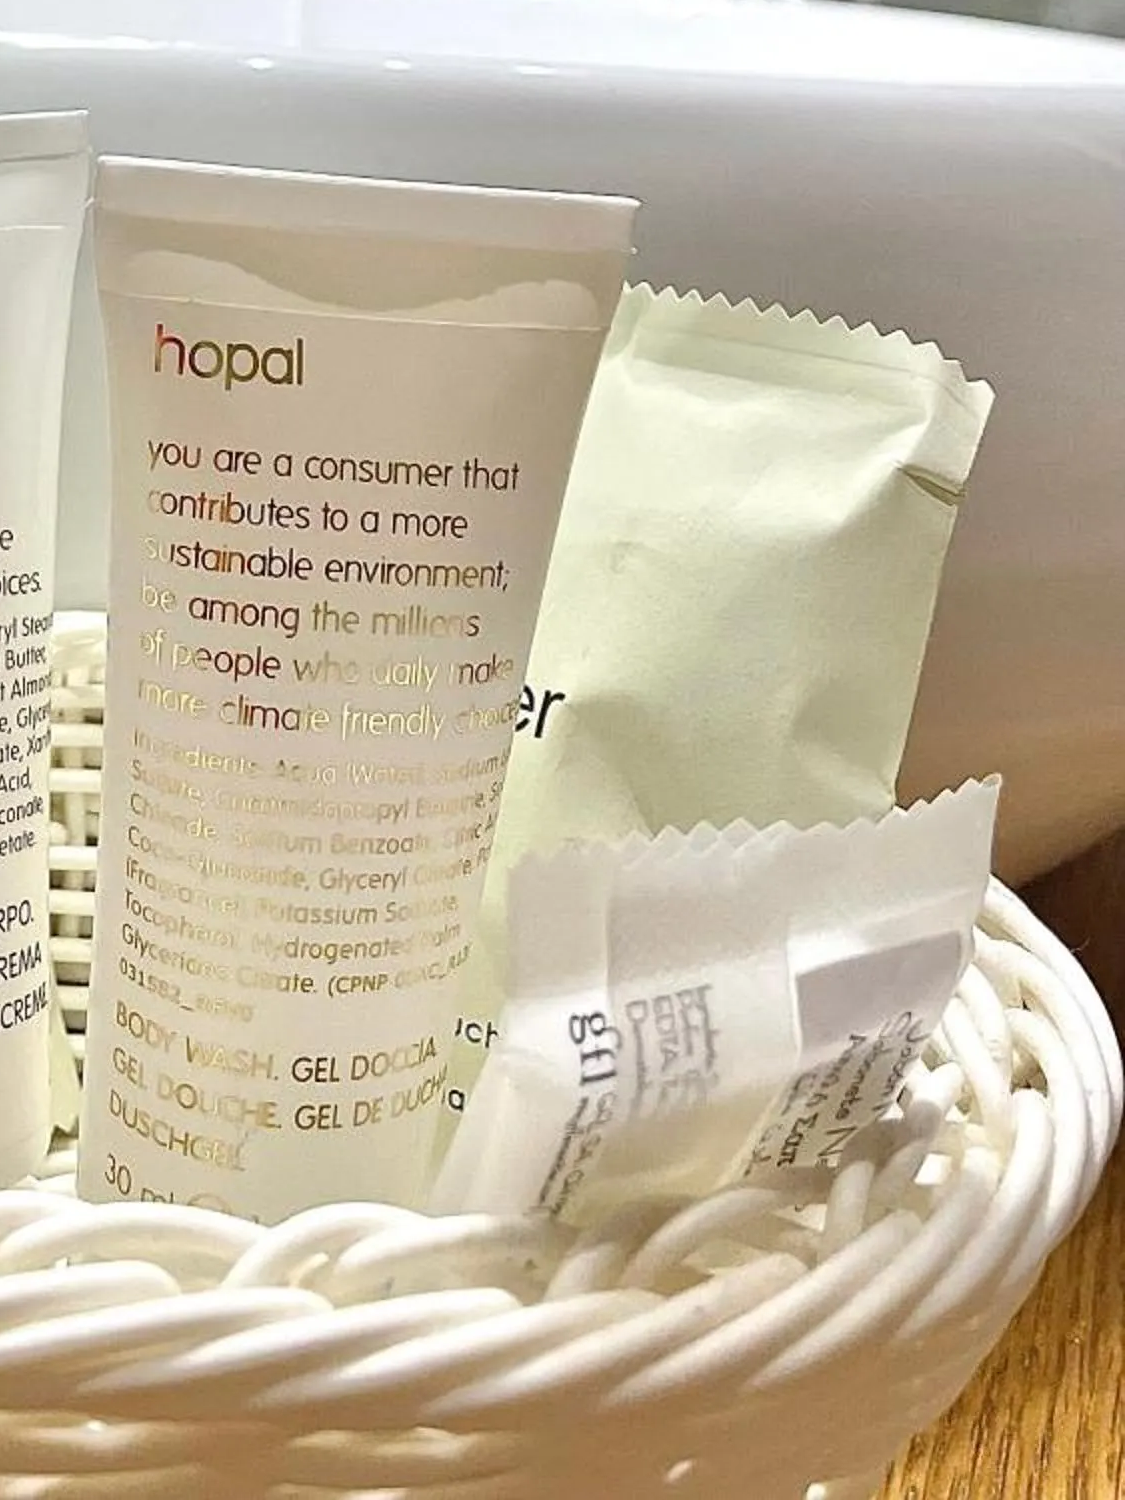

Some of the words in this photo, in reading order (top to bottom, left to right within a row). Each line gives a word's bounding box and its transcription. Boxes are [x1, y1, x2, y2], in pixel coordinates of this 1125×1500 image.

[154, 324, 304, 390] hopal
[148, 439, 201, 471] you
[213, 447, 261, 475] are
[274, 452, 292, 477] a
[305, 453, 452, 488] consumer
[463, 458, 519, 491] that
[149, 489, 309, 529] contributes
[322, 501, 347, 531] to
[360, 507, 378, 533] a
[392, 511, 468, 539] more
[146, 536, 312, 581] sustainable
[325, 555, 511, 592] environment;
[143, 583, 176, 613] be
[189, 594, 300, 638] among
[311, 602, 360, 635] the
[371, 605, 480, 638] millions
[140, 628, 167, 663] of
[172, 643, 281, 682] people
[294, 654, 360, 685] who
[219, 694, 330, 733] climate
[341, 704, 444, 740] friendly
[319, 857, 407, 895] Glyceryl
[328, 975, 386, 999] (CPNP
[115, 1000, 176, 1052] BODY
[186, 1035, 280, 1082] WASH.
[292, 1055, 339, 1083] GEL
[112, 1046, 149, 1089] GEL
[295, 1105, 342, 1131] GEL
[353, 1098, 385, 1129] DE
[104, 1153, 131, 1197] 30
